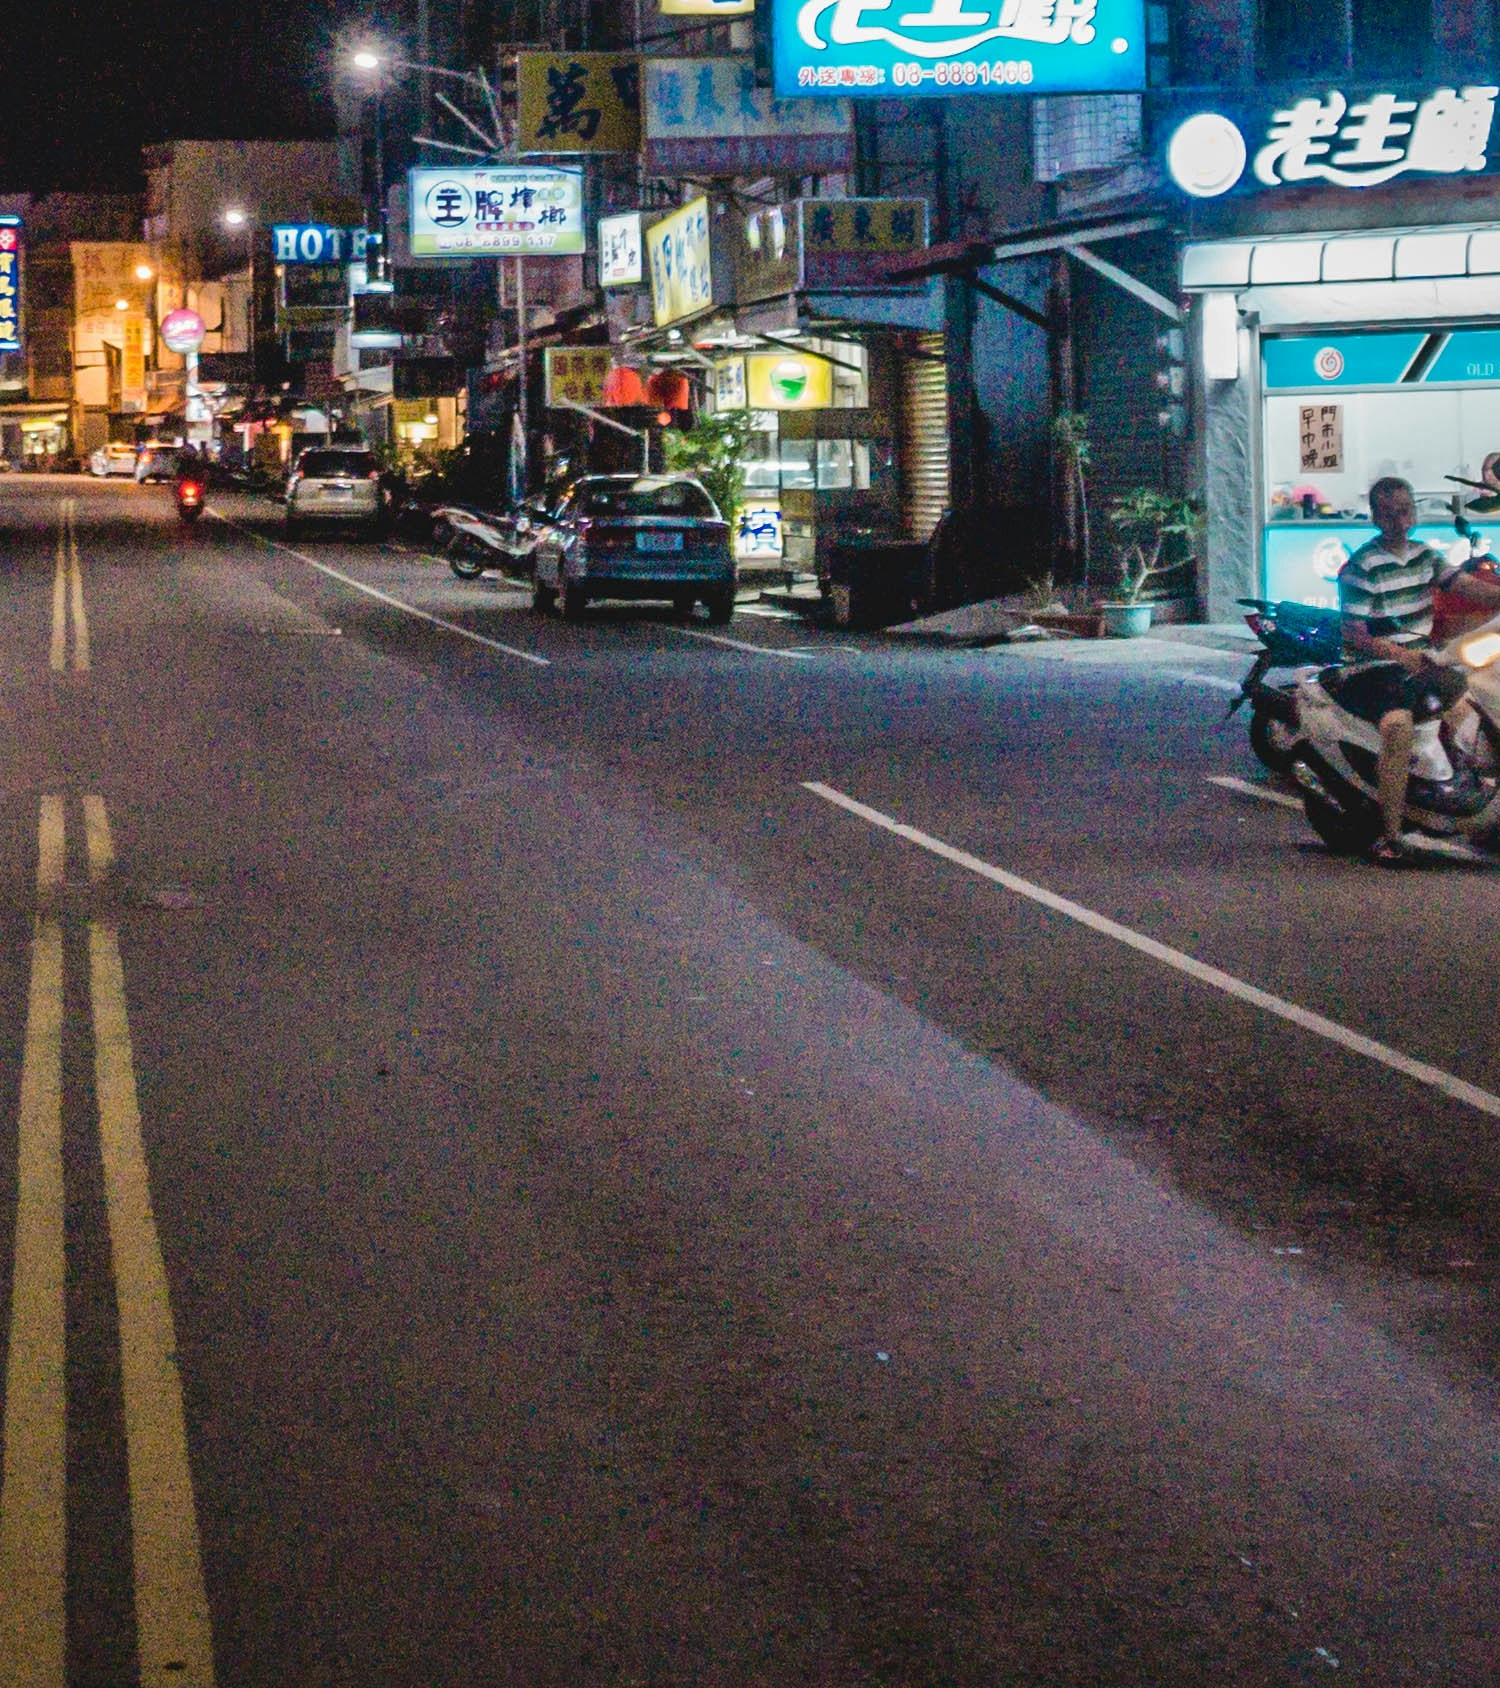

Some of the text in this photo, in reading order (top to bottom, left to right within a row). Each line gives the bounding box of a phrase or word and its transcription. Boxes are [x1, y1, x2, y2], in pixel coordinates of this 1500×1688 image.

[1254, 86, 1500, 188] 老主顧
[274, 227, 369, 261] HOTE
[1466, 361, 1494, 377] OLD
